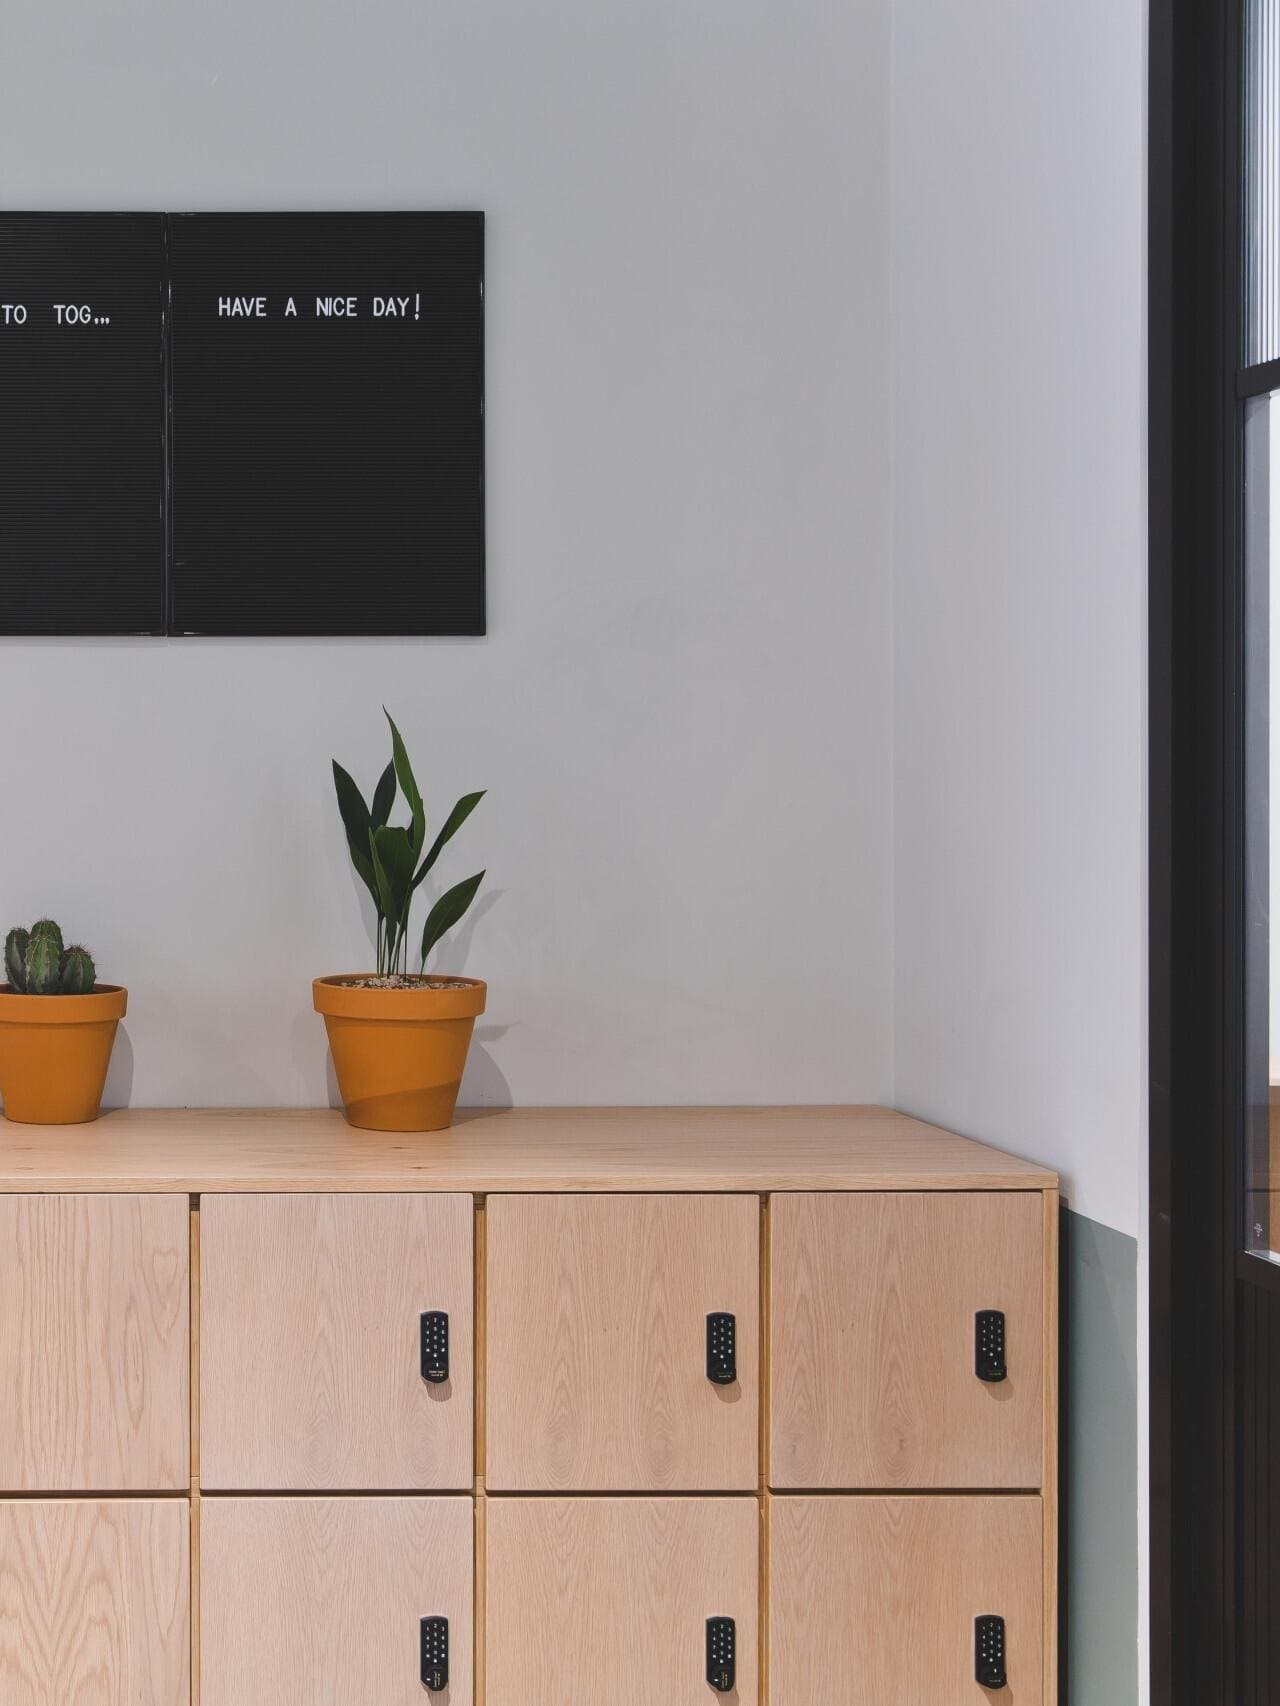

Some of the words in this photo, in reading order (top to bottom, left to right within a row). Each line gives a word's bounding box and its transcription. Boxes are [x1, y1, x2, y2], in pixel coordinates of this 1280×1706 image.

[1, 304, 27, 325] TO
[218, 296, 267, 317] HAVE
[284, 296, 298, 317] A
[316, 296, 358, 317] NICE
[372, 293, 420, 321] DAY!
